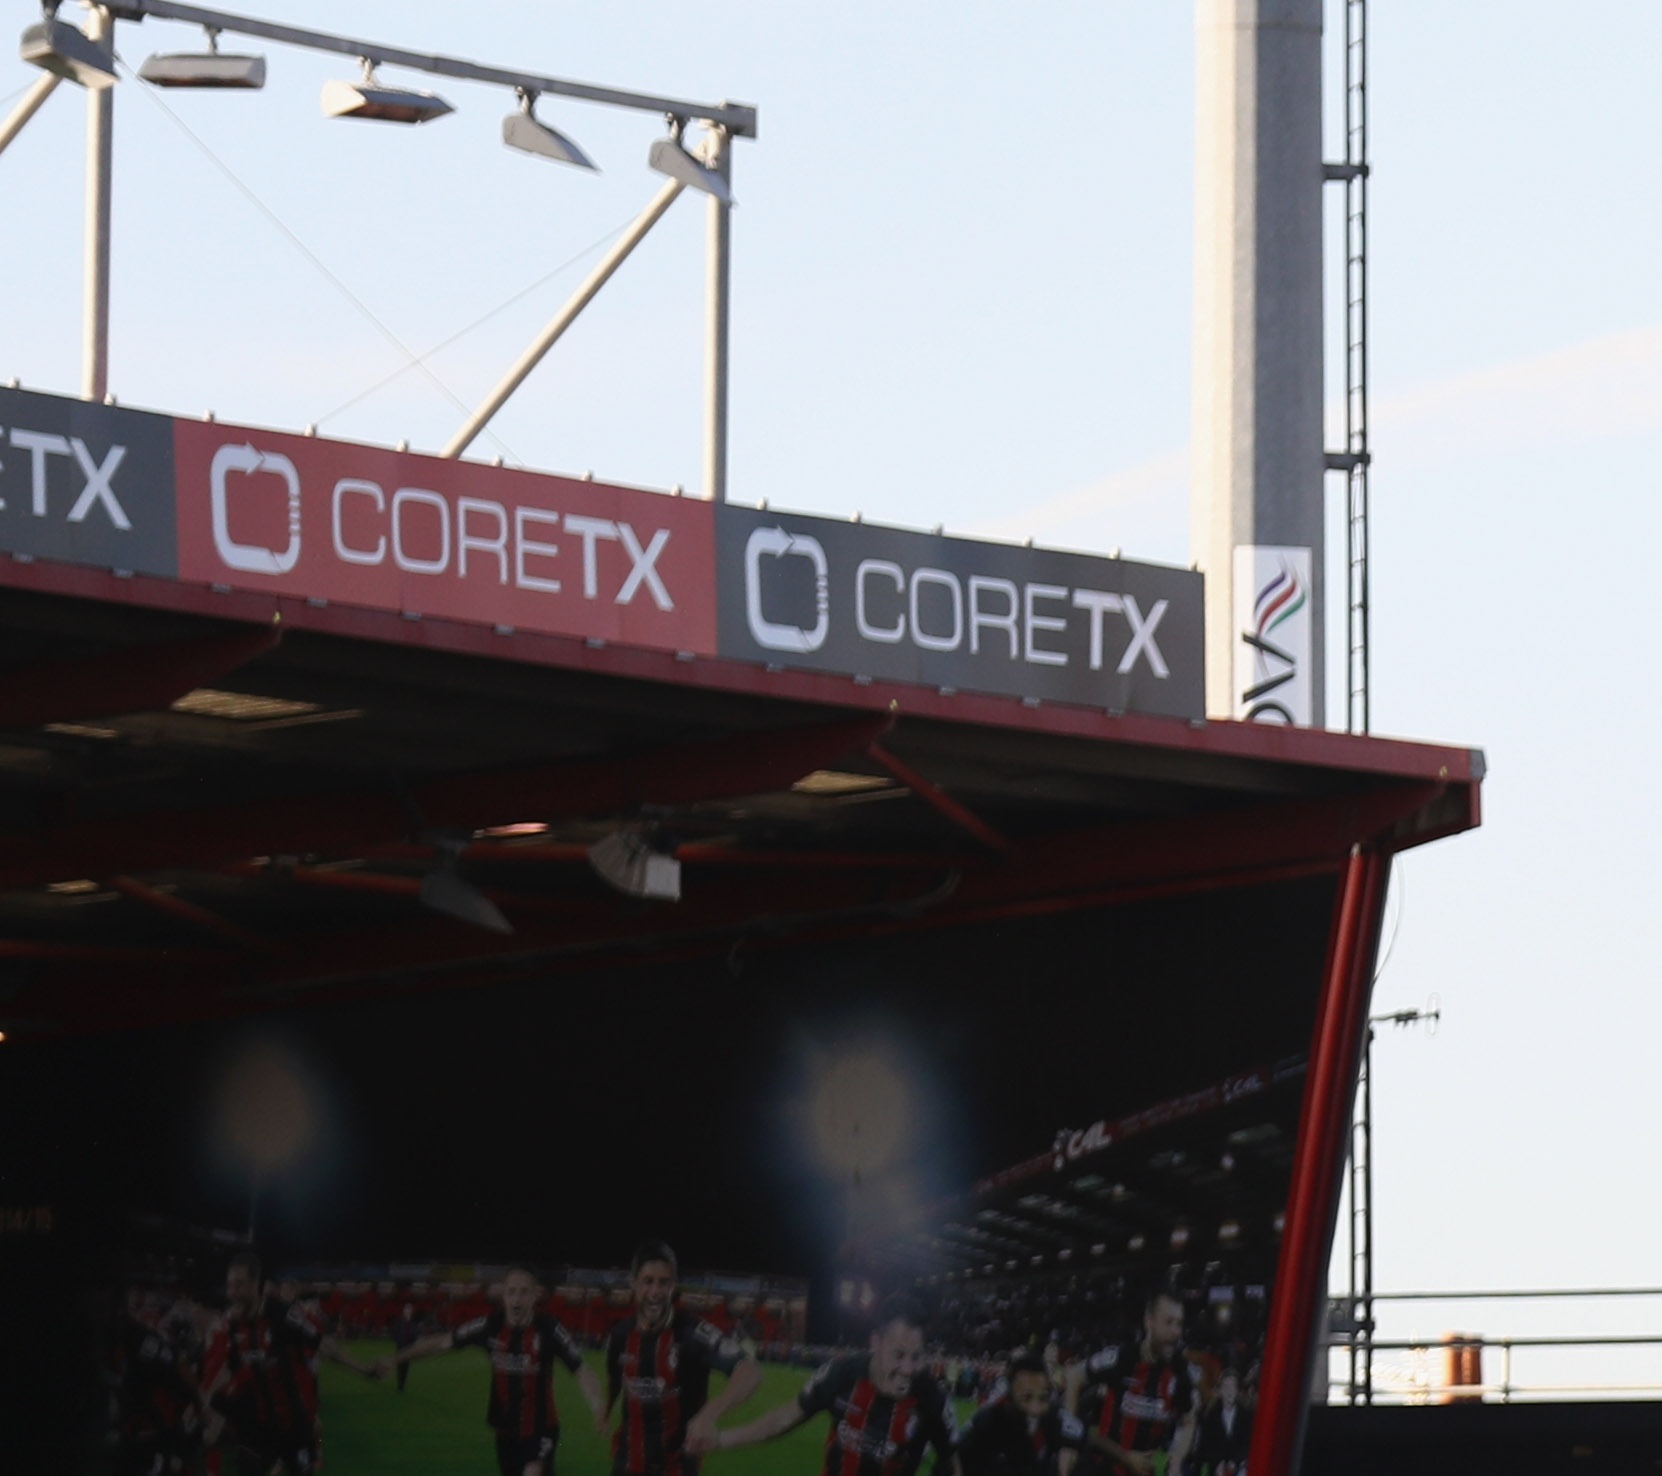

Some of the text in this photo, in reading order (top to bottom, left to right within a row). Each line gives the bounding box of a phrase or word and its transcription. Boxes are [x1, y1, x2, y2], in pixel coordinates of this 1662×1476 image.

[0, 426, 132, 532] TX
[331, 477, 675, 613] CORETX
[855, 558, 1170, 679] CORETX
